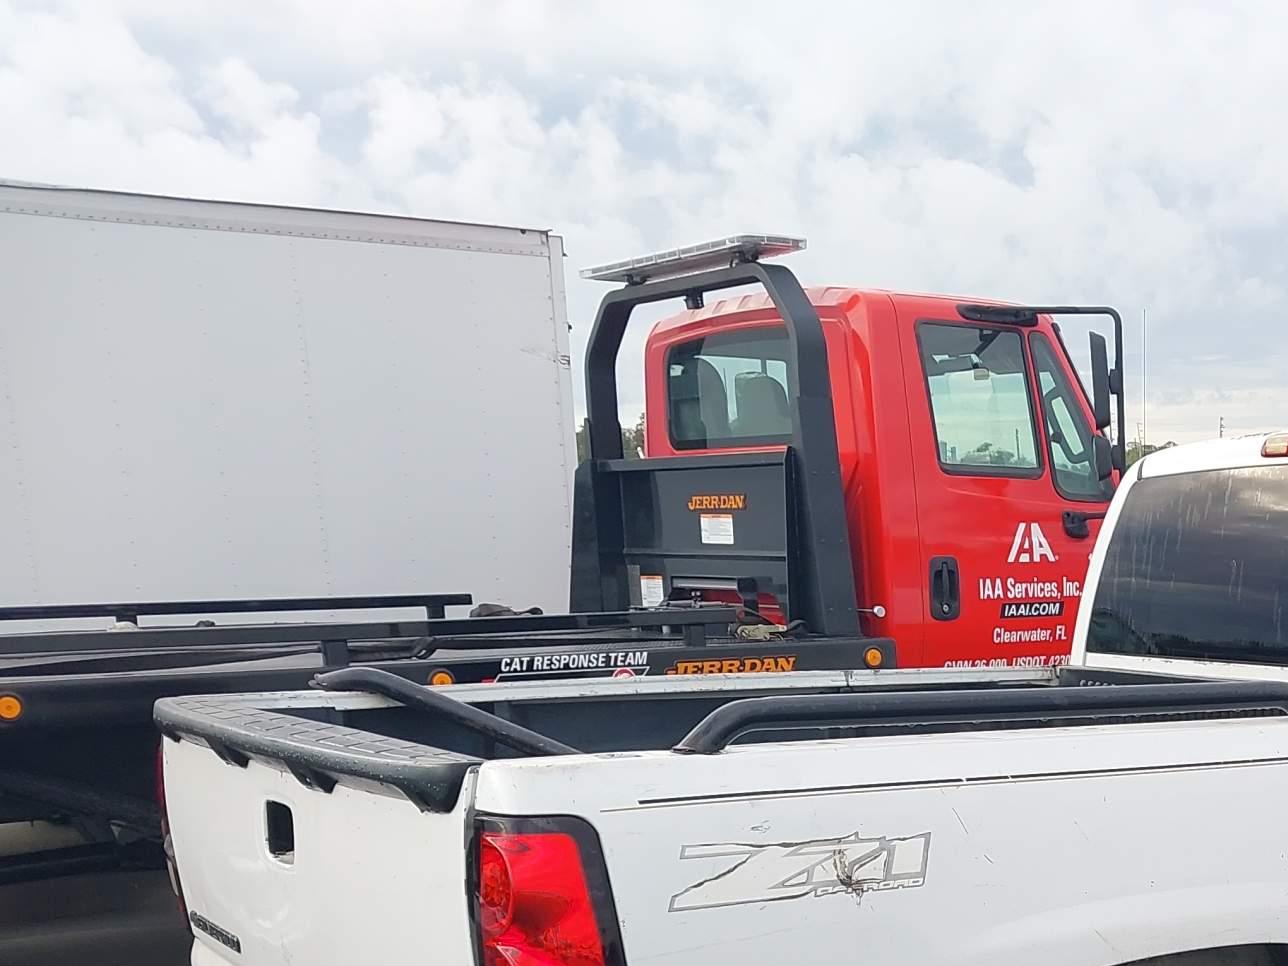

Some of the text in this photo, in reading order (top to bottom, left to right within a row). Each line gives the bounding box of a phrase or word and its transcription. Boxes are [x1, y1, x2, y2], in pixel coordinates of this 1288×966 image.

[979, 576, 1082, 600] IAA Services, Inc.
[1004, 602, 1060, 617] IAAI.COM
[993, 625, 1067, 644] Clearwater, FL
[501, 652, 648, 672] CAT RESPONSE TEAM
[975, 658, 1007, 668] 26000
